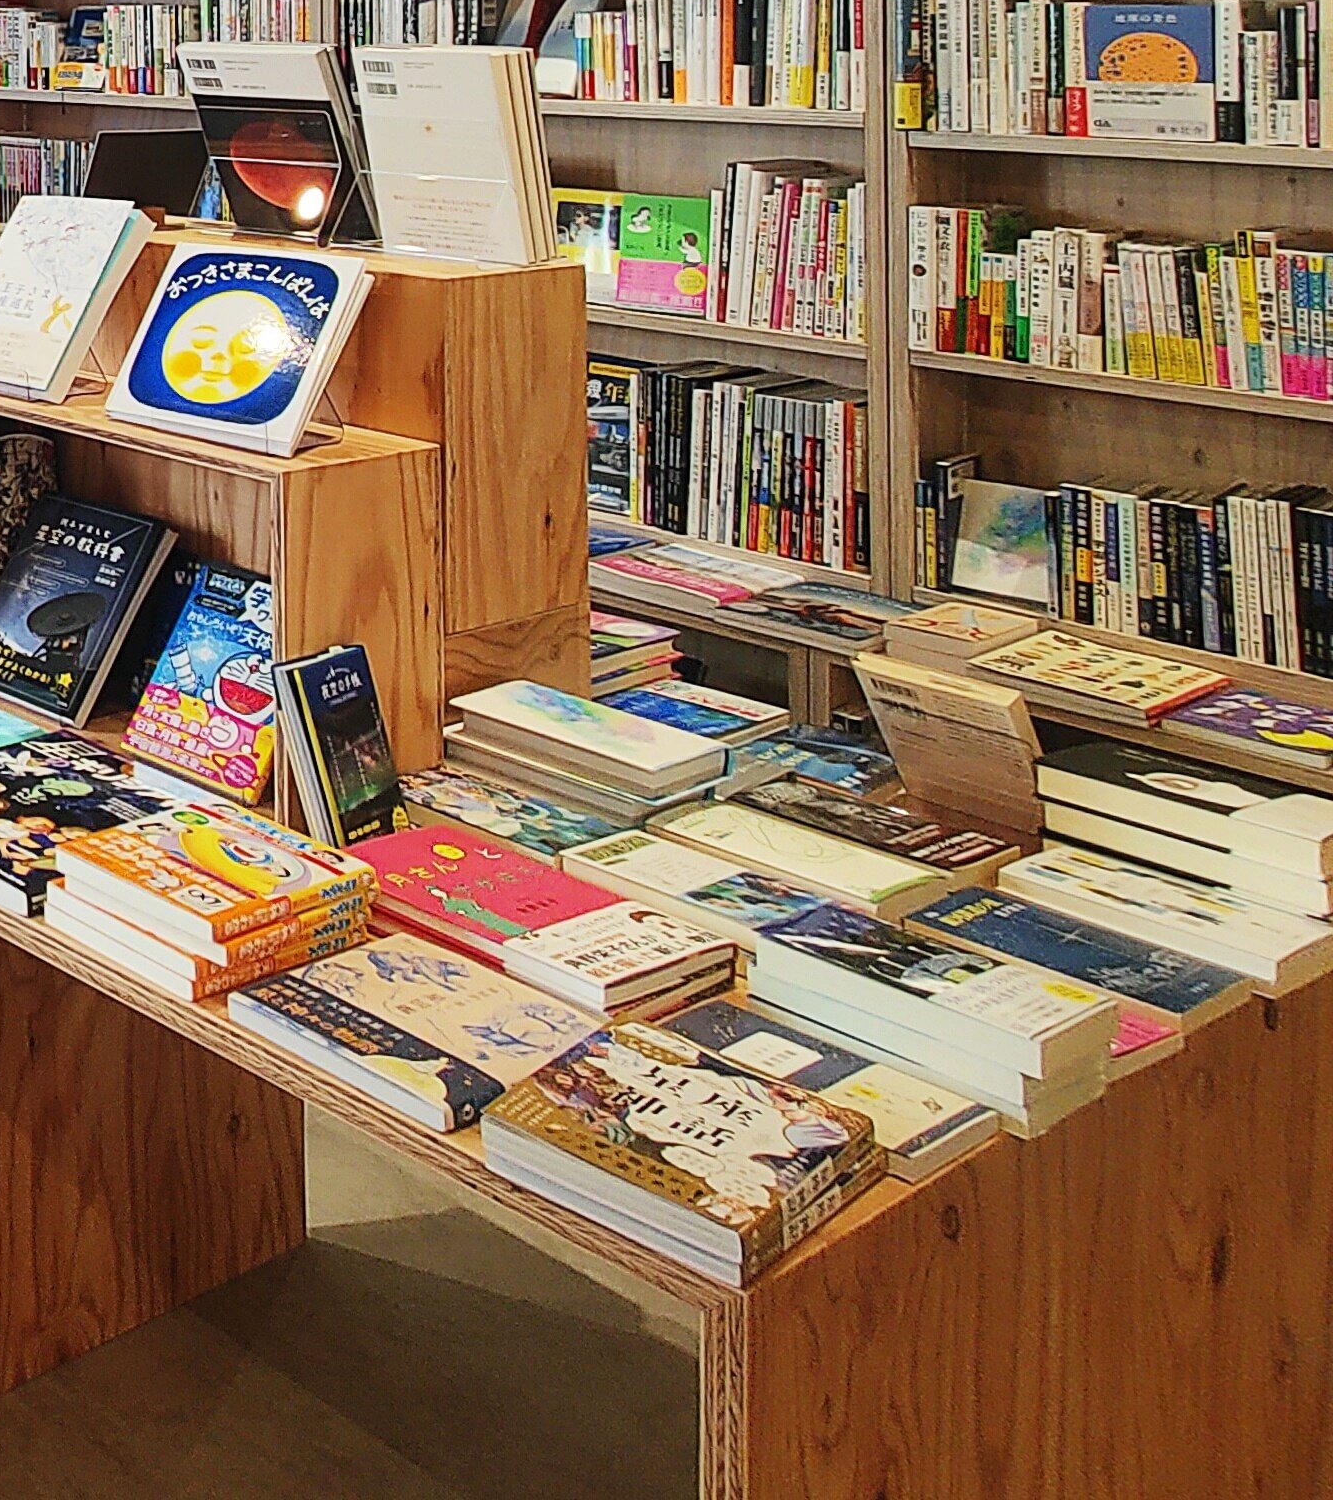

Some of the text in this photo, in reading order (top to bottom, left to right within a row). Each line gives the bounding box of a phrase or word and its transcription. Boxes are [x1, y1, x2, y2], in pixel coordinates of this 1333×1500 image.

[166, 260, 329, 320] おつきさまこんばんは
[35, 524, 126, 562] 星空の教科書
[384, 860, 459, 888] 月さん
